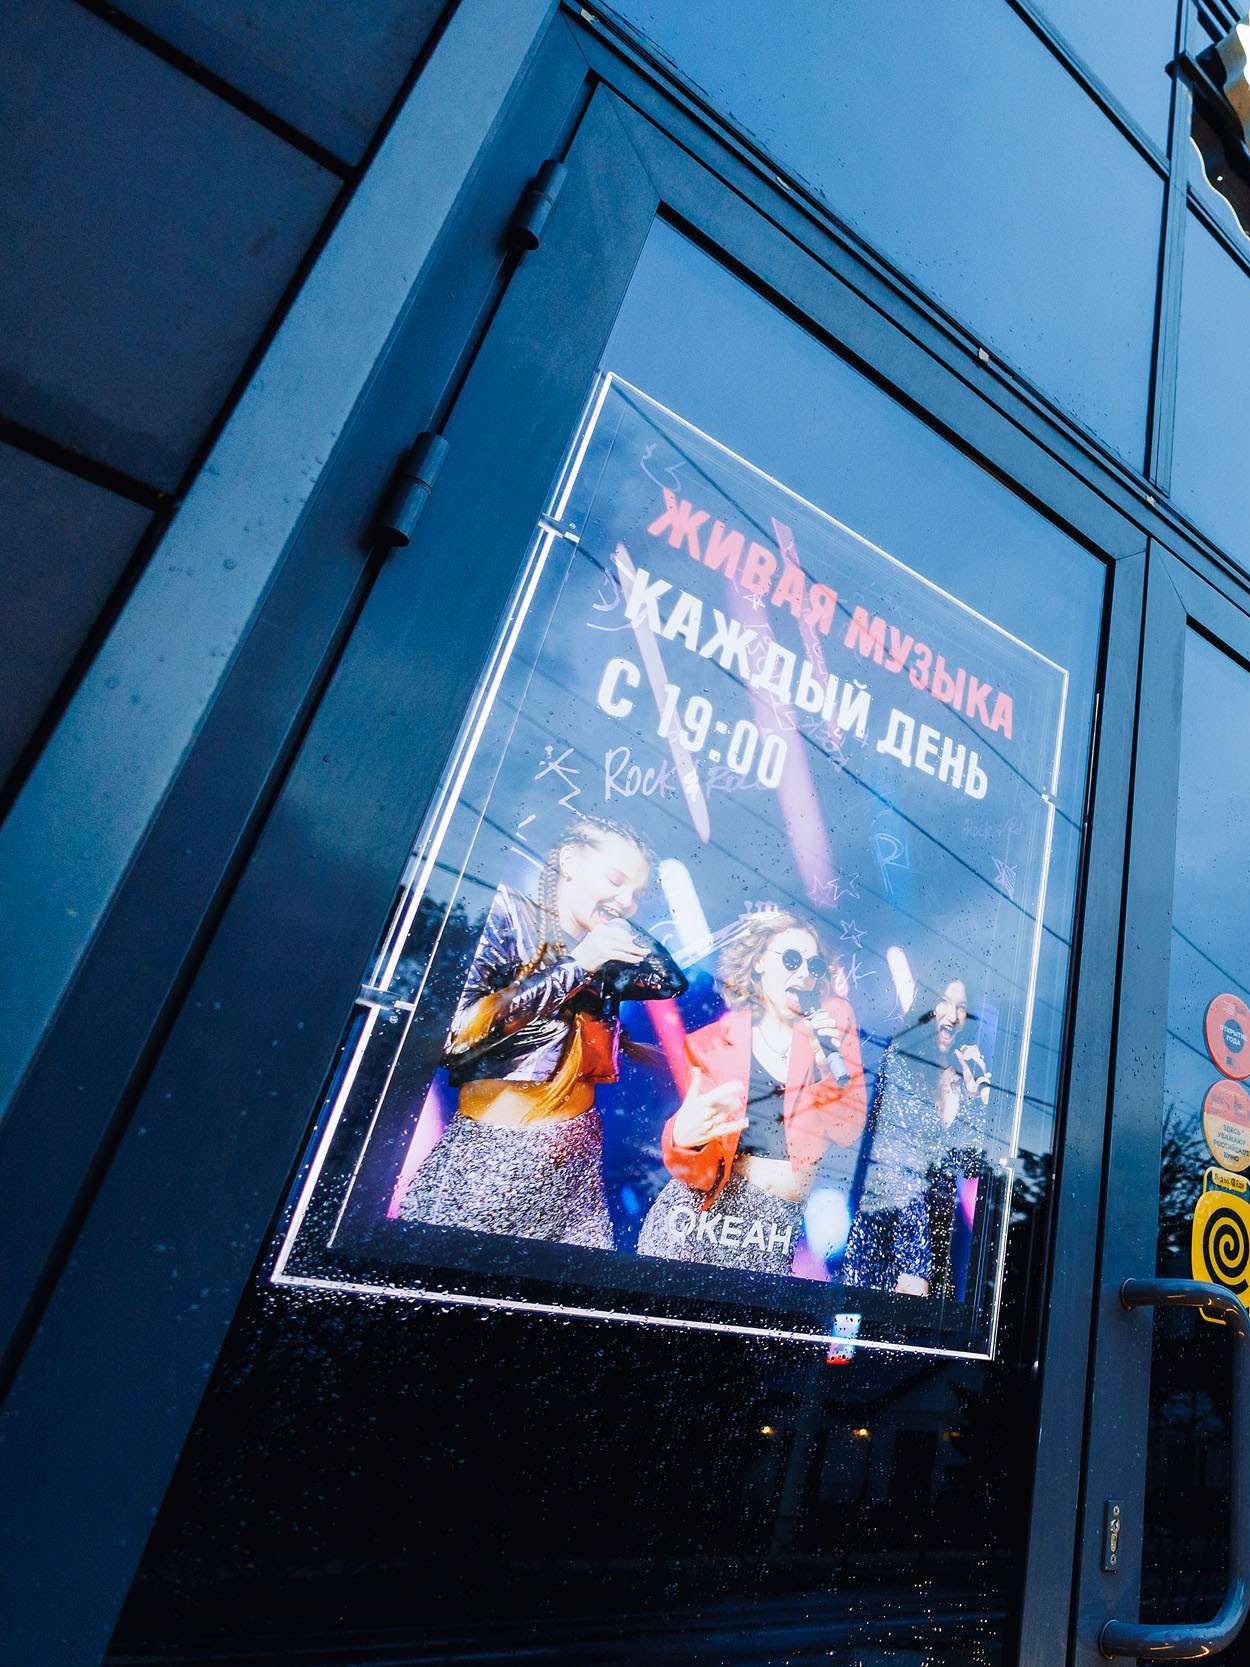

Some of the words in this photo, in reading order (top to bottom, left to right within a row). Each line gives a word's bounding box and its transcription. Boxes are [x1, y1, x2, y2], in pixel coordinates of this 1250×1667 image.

[646, 487, 838, 636] ЖИВАЯ
[843, 605, 1013, 740] МУЗЫКА
[597, 658, 641, 718] С
[656, 683, 788, 788] 19:00
[624, 567, 872, 739] КАЖДЫЙ
[876, 707, 988, 800] ДЕНЬ
[1226, 1034, 1241, 1047] ГОДА
[663, 1204, 793, 1255] ОКЕАН
